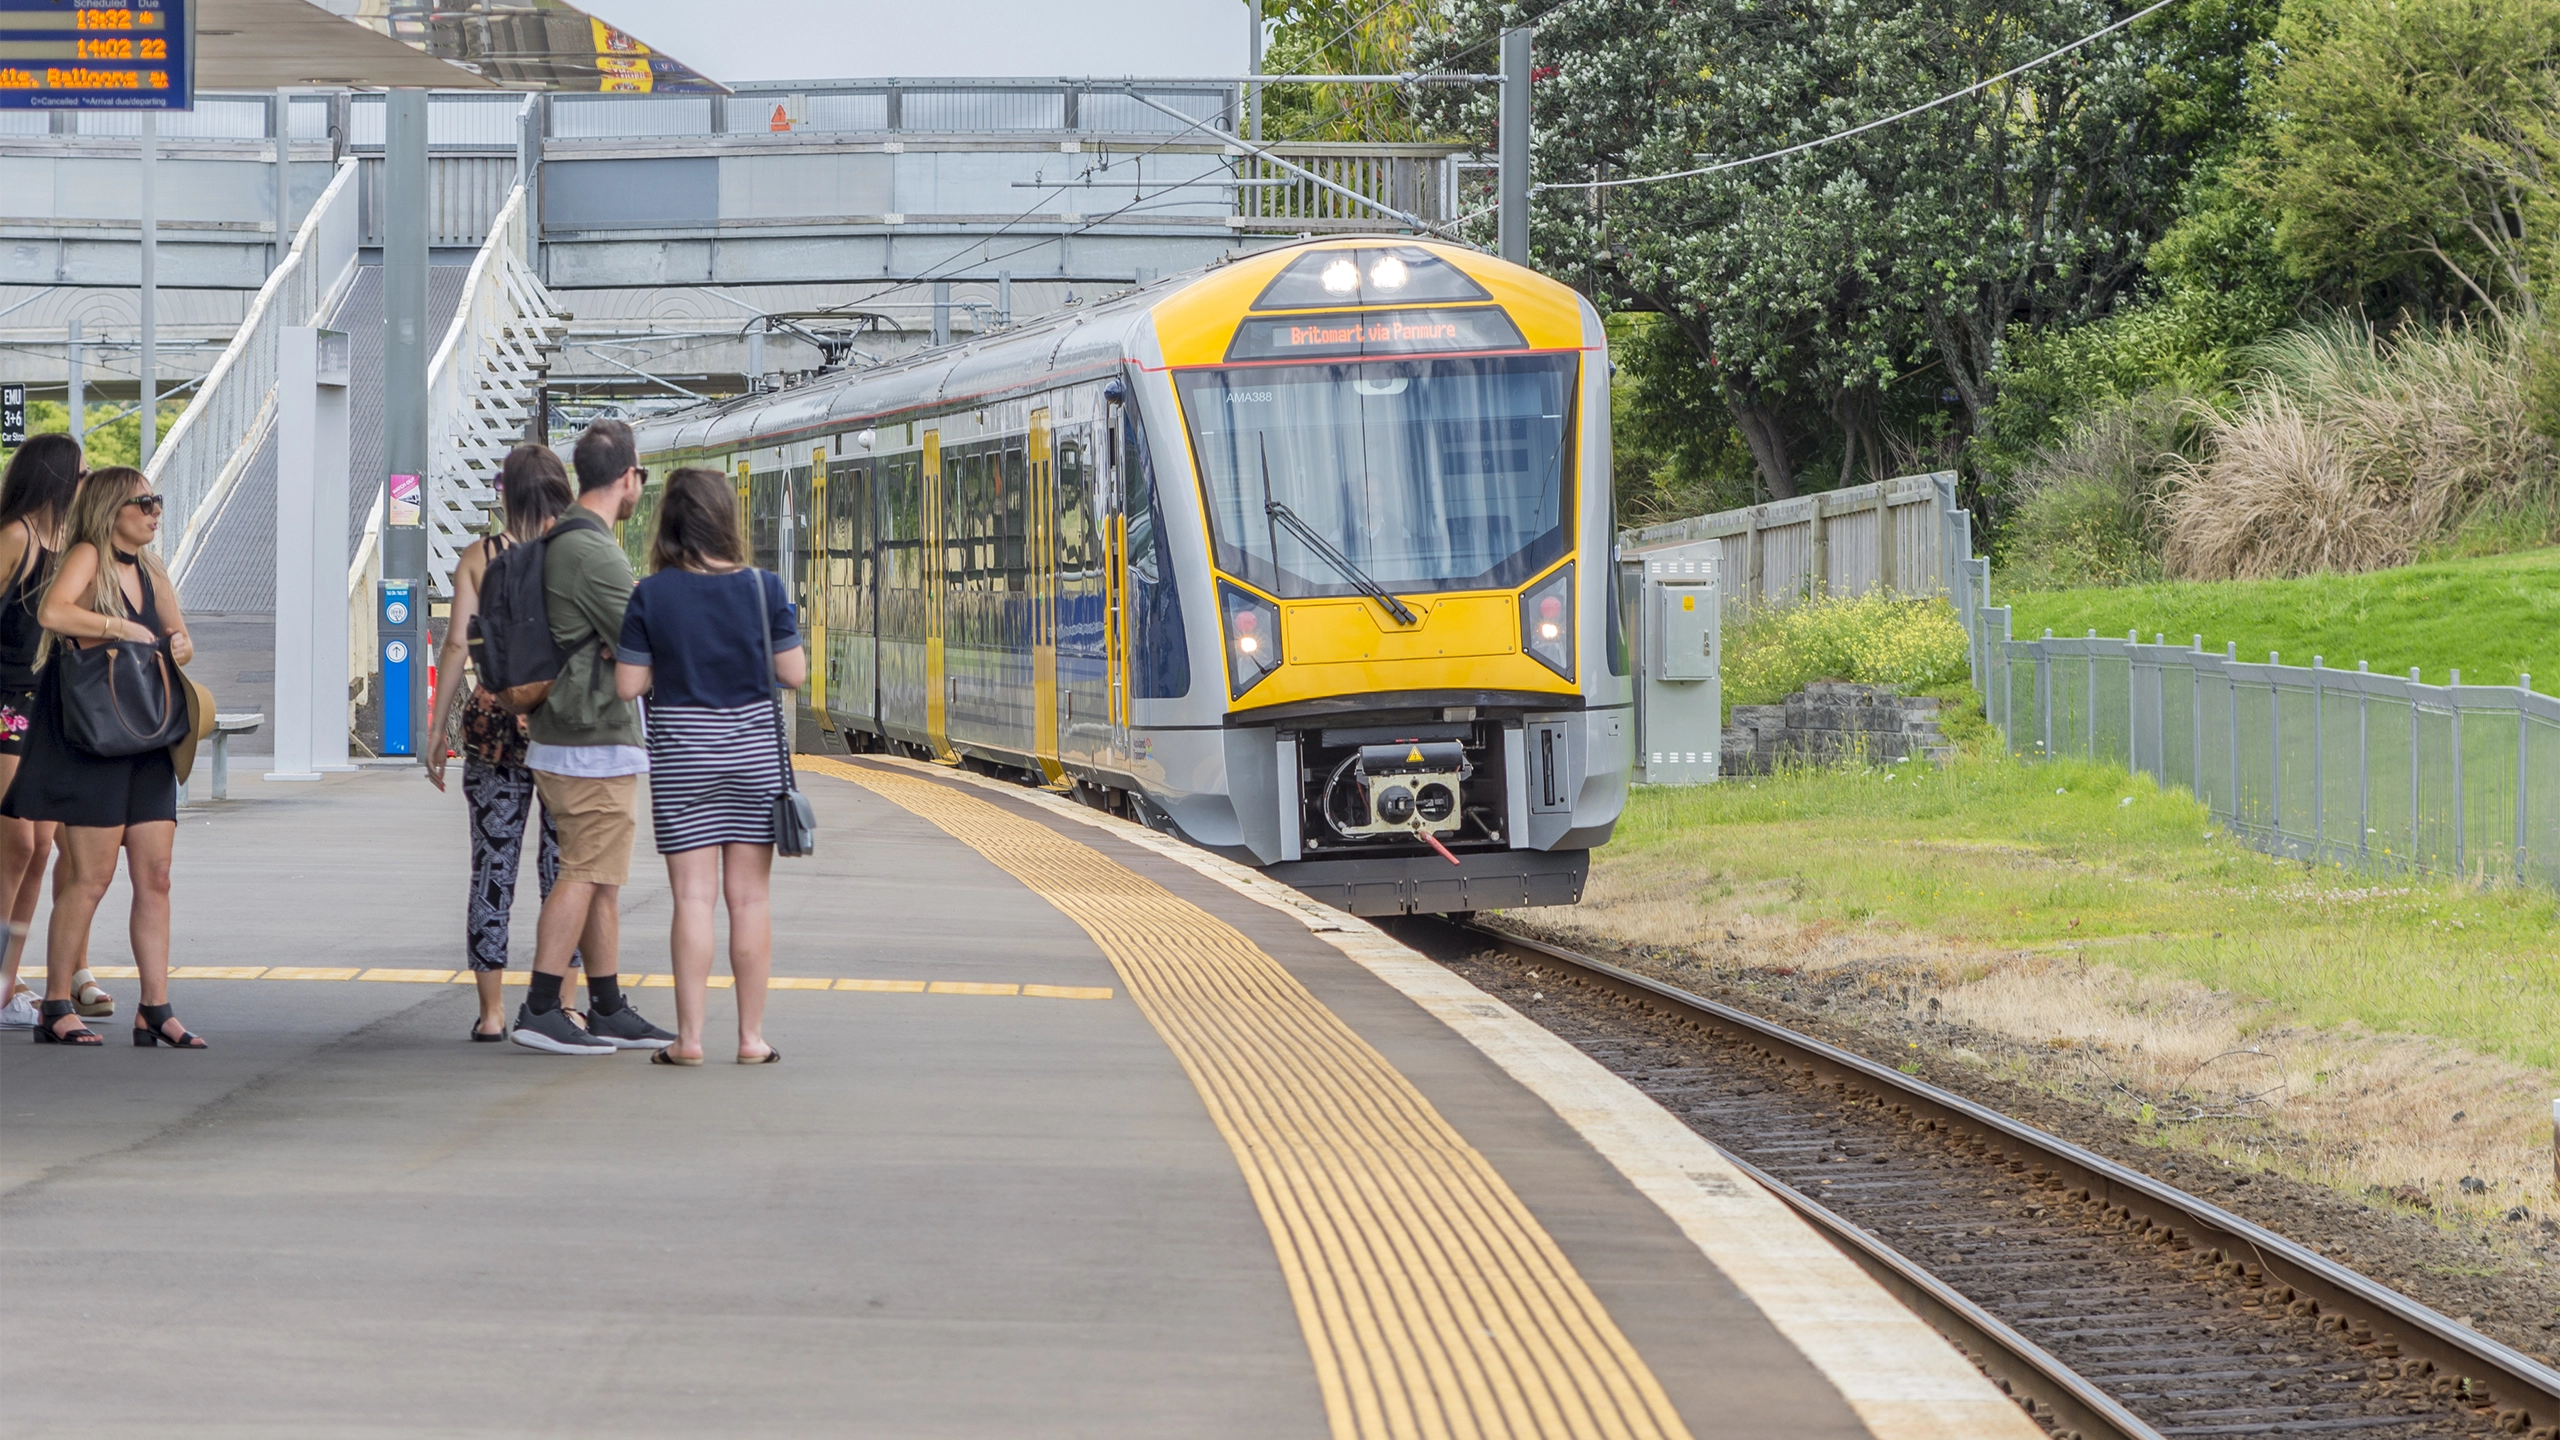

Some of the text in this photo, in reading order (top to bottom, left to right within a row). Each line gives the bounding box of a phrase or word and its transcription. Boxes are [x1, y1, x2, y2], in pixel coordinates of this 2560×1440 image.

[74, 0, 159, 8] Scheduled Due
[76, 9, 132, 29] 13:32
[77, 38, 167, 59] 14:02 22
[47, 68, 139, 88] Balloons
[31, 97, 78, 105] C=Cancelled
[115, 97, 166, 107] due/departing
[1291, 322, 1456, 345] Britomart via Panmure
[4, 389, 21, 405] EMU
[1226, 392, 1273, 403] AMA388
[4, 410, 22, 427] 3+6
